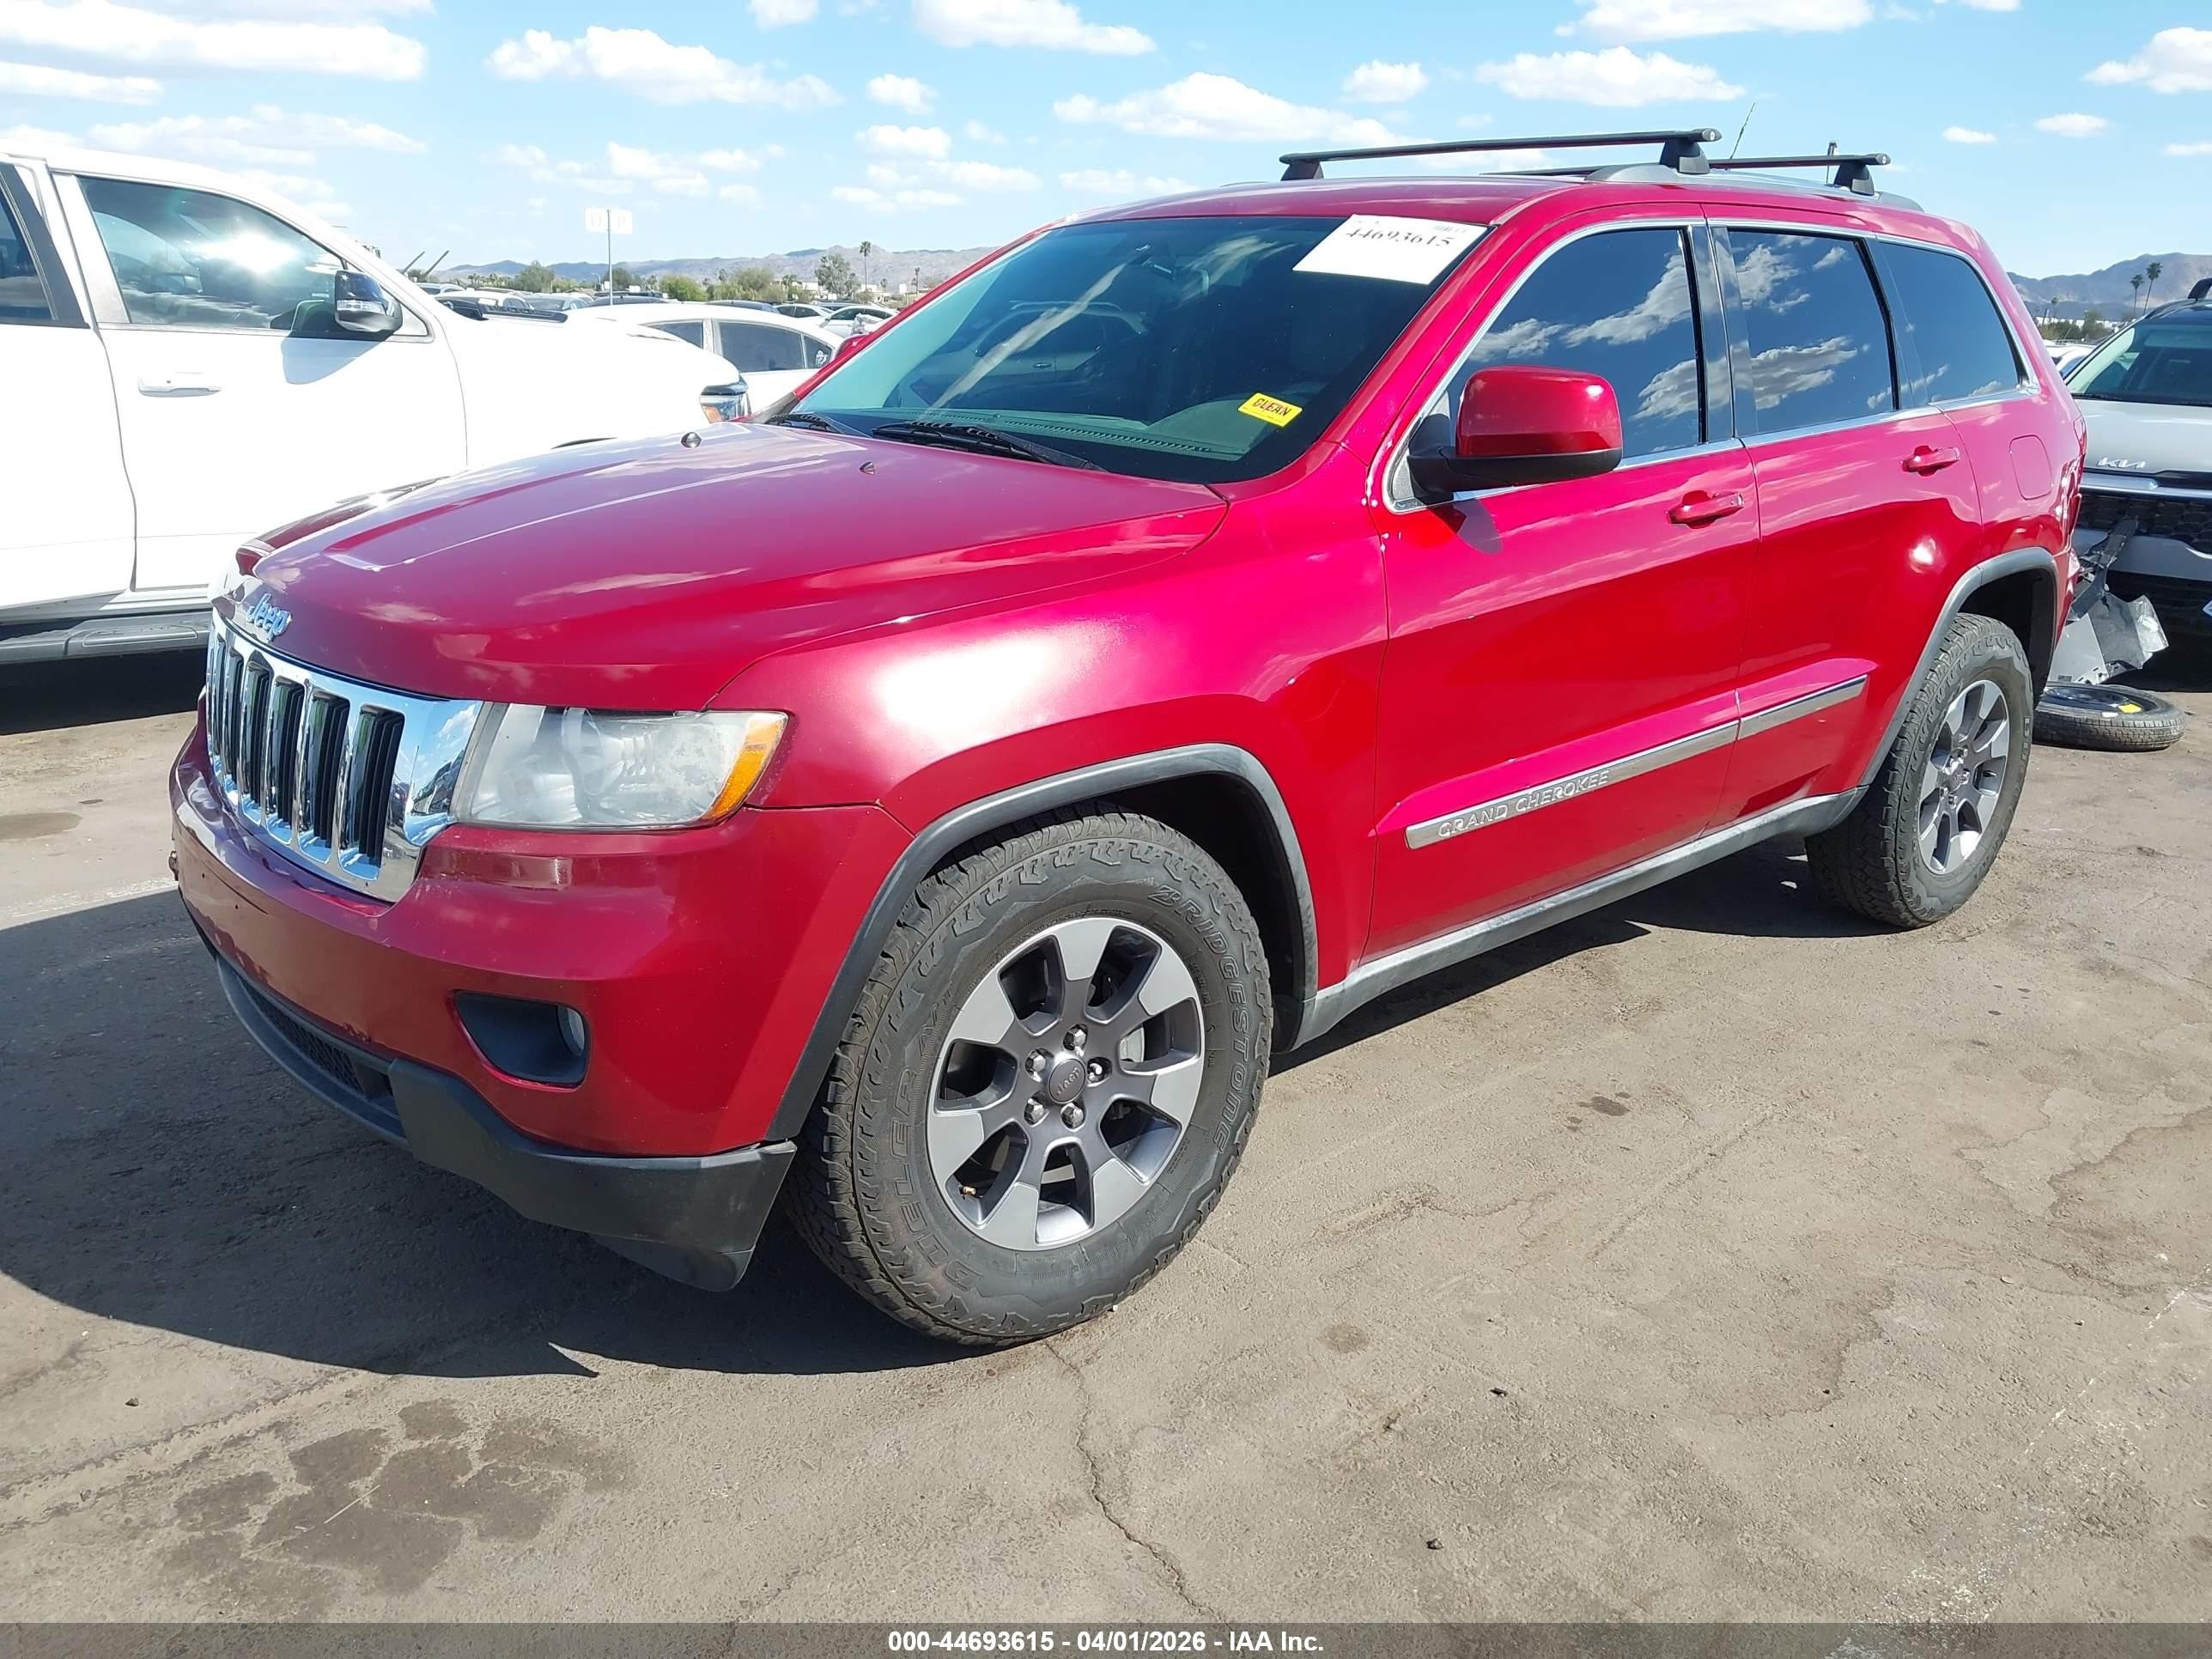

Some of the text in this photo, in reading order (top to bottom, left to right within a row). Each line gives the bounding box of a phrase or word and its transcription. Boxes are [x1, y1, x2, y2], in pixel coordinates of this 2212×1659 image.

[1346, 228, 1455, 247] 44693615
[1251, 398, 1292, 416] CLEAN
[246, 592, 292, 642] Jeep
[1437, 770, 1611, 839] GRAND CHEROKEE
[1147, 884, 1250, 1156] BRIDGESTONE
[1055, 1066, 1080, 1096] Jeep
